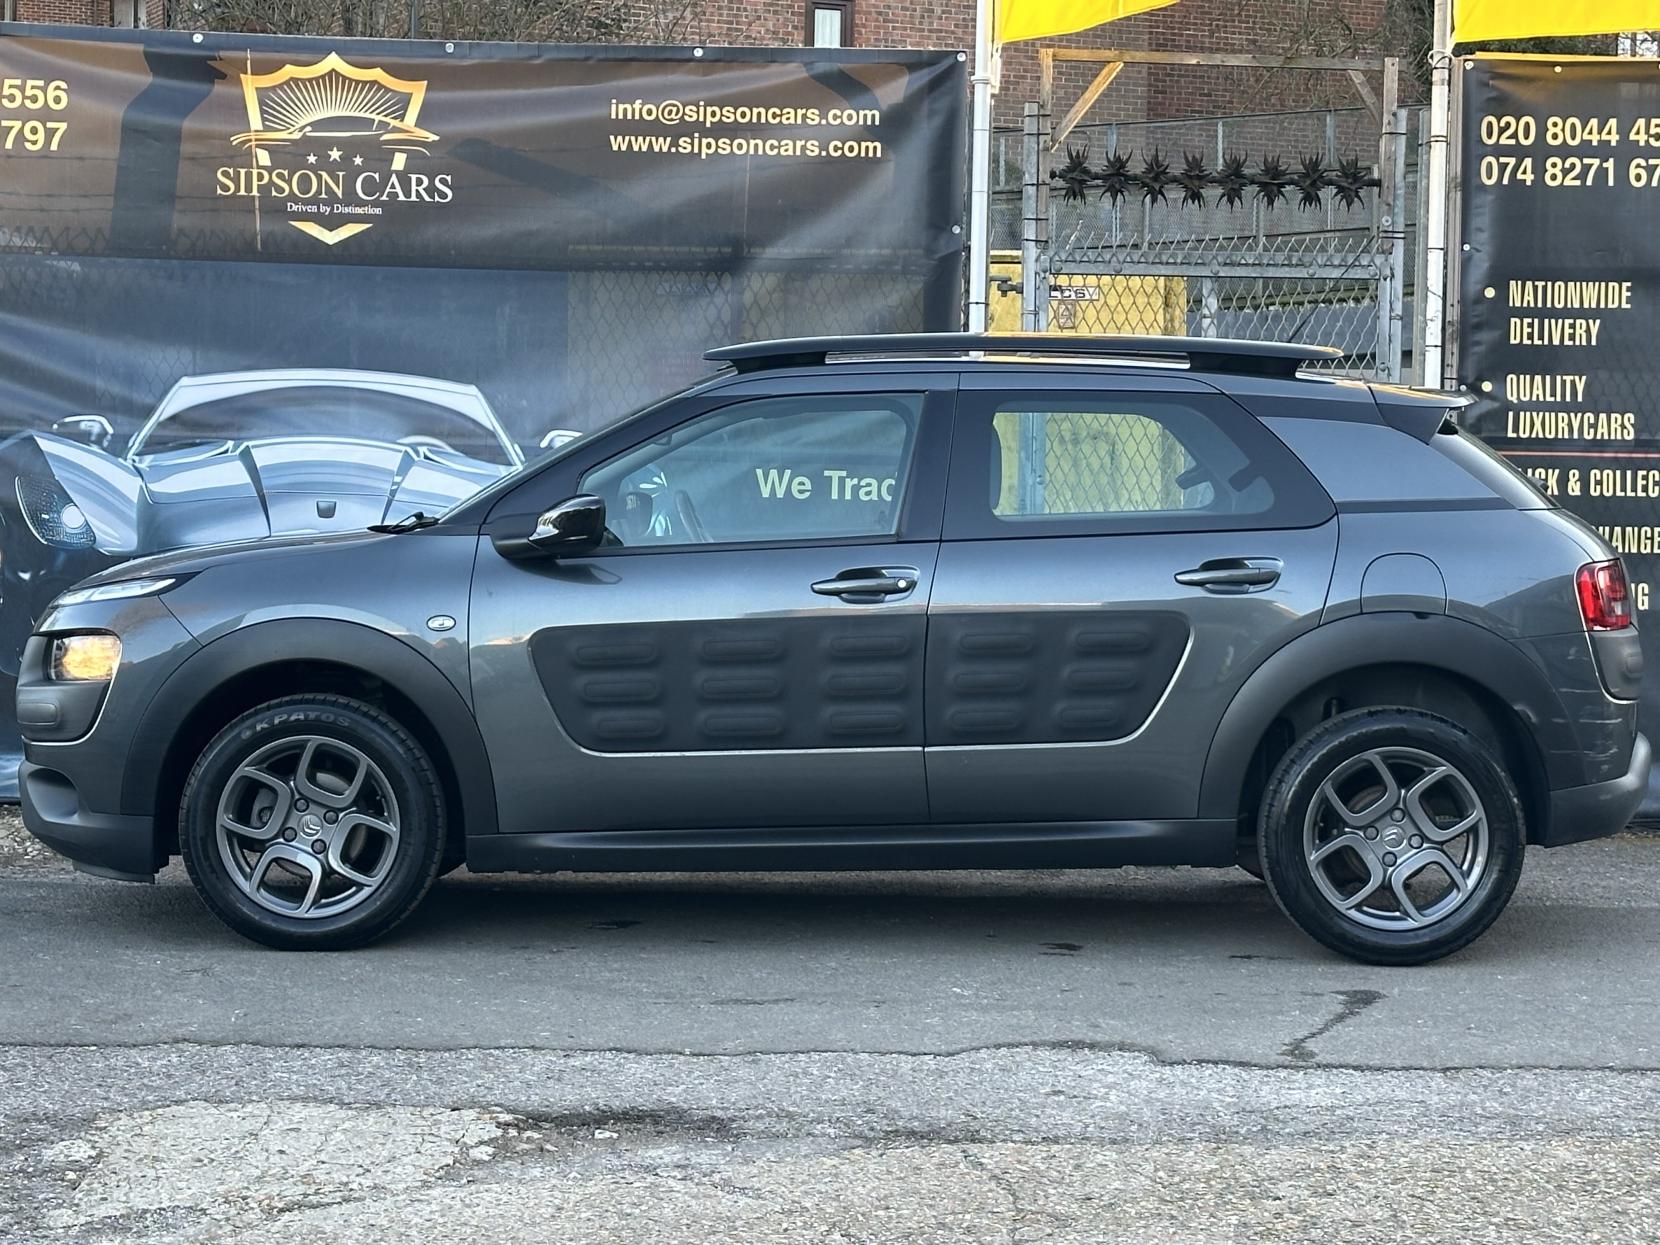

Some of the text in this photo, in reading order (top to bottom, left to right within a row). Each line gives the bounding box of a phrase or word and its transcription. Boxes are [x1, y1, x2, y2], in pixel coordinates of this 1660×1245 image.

[1, 78, 69, 111] 556
[610, 99, 880, 127] info@sipsoncars.com
[1, 119, 68, 152] 797
[609, 133, 882, 159] www.sipsoncars.com
[1480, 115, 1537, 146] 020
[1545, 116, 1620, 147] 8044
[216, 167, 453, 203] SIPSON CARS
[1480, 155, 1535, 186] 074
[1544, 156, 1615, 187] 8271
[287, 202, 382, 215] Driven by Distinction
[1508, 280, 1632, 309] NATIONWIDE
[1509, 317, 1601, 346] DELIVERY
[1506, 374, 1587, 404] QUALITY
[1507, 411, 1635, 441] LUXURYCARS
[755, 468, 812, 500] We
[1567, 468, 1581, 496] &
[255, 711, 352, 732] KPATOS
